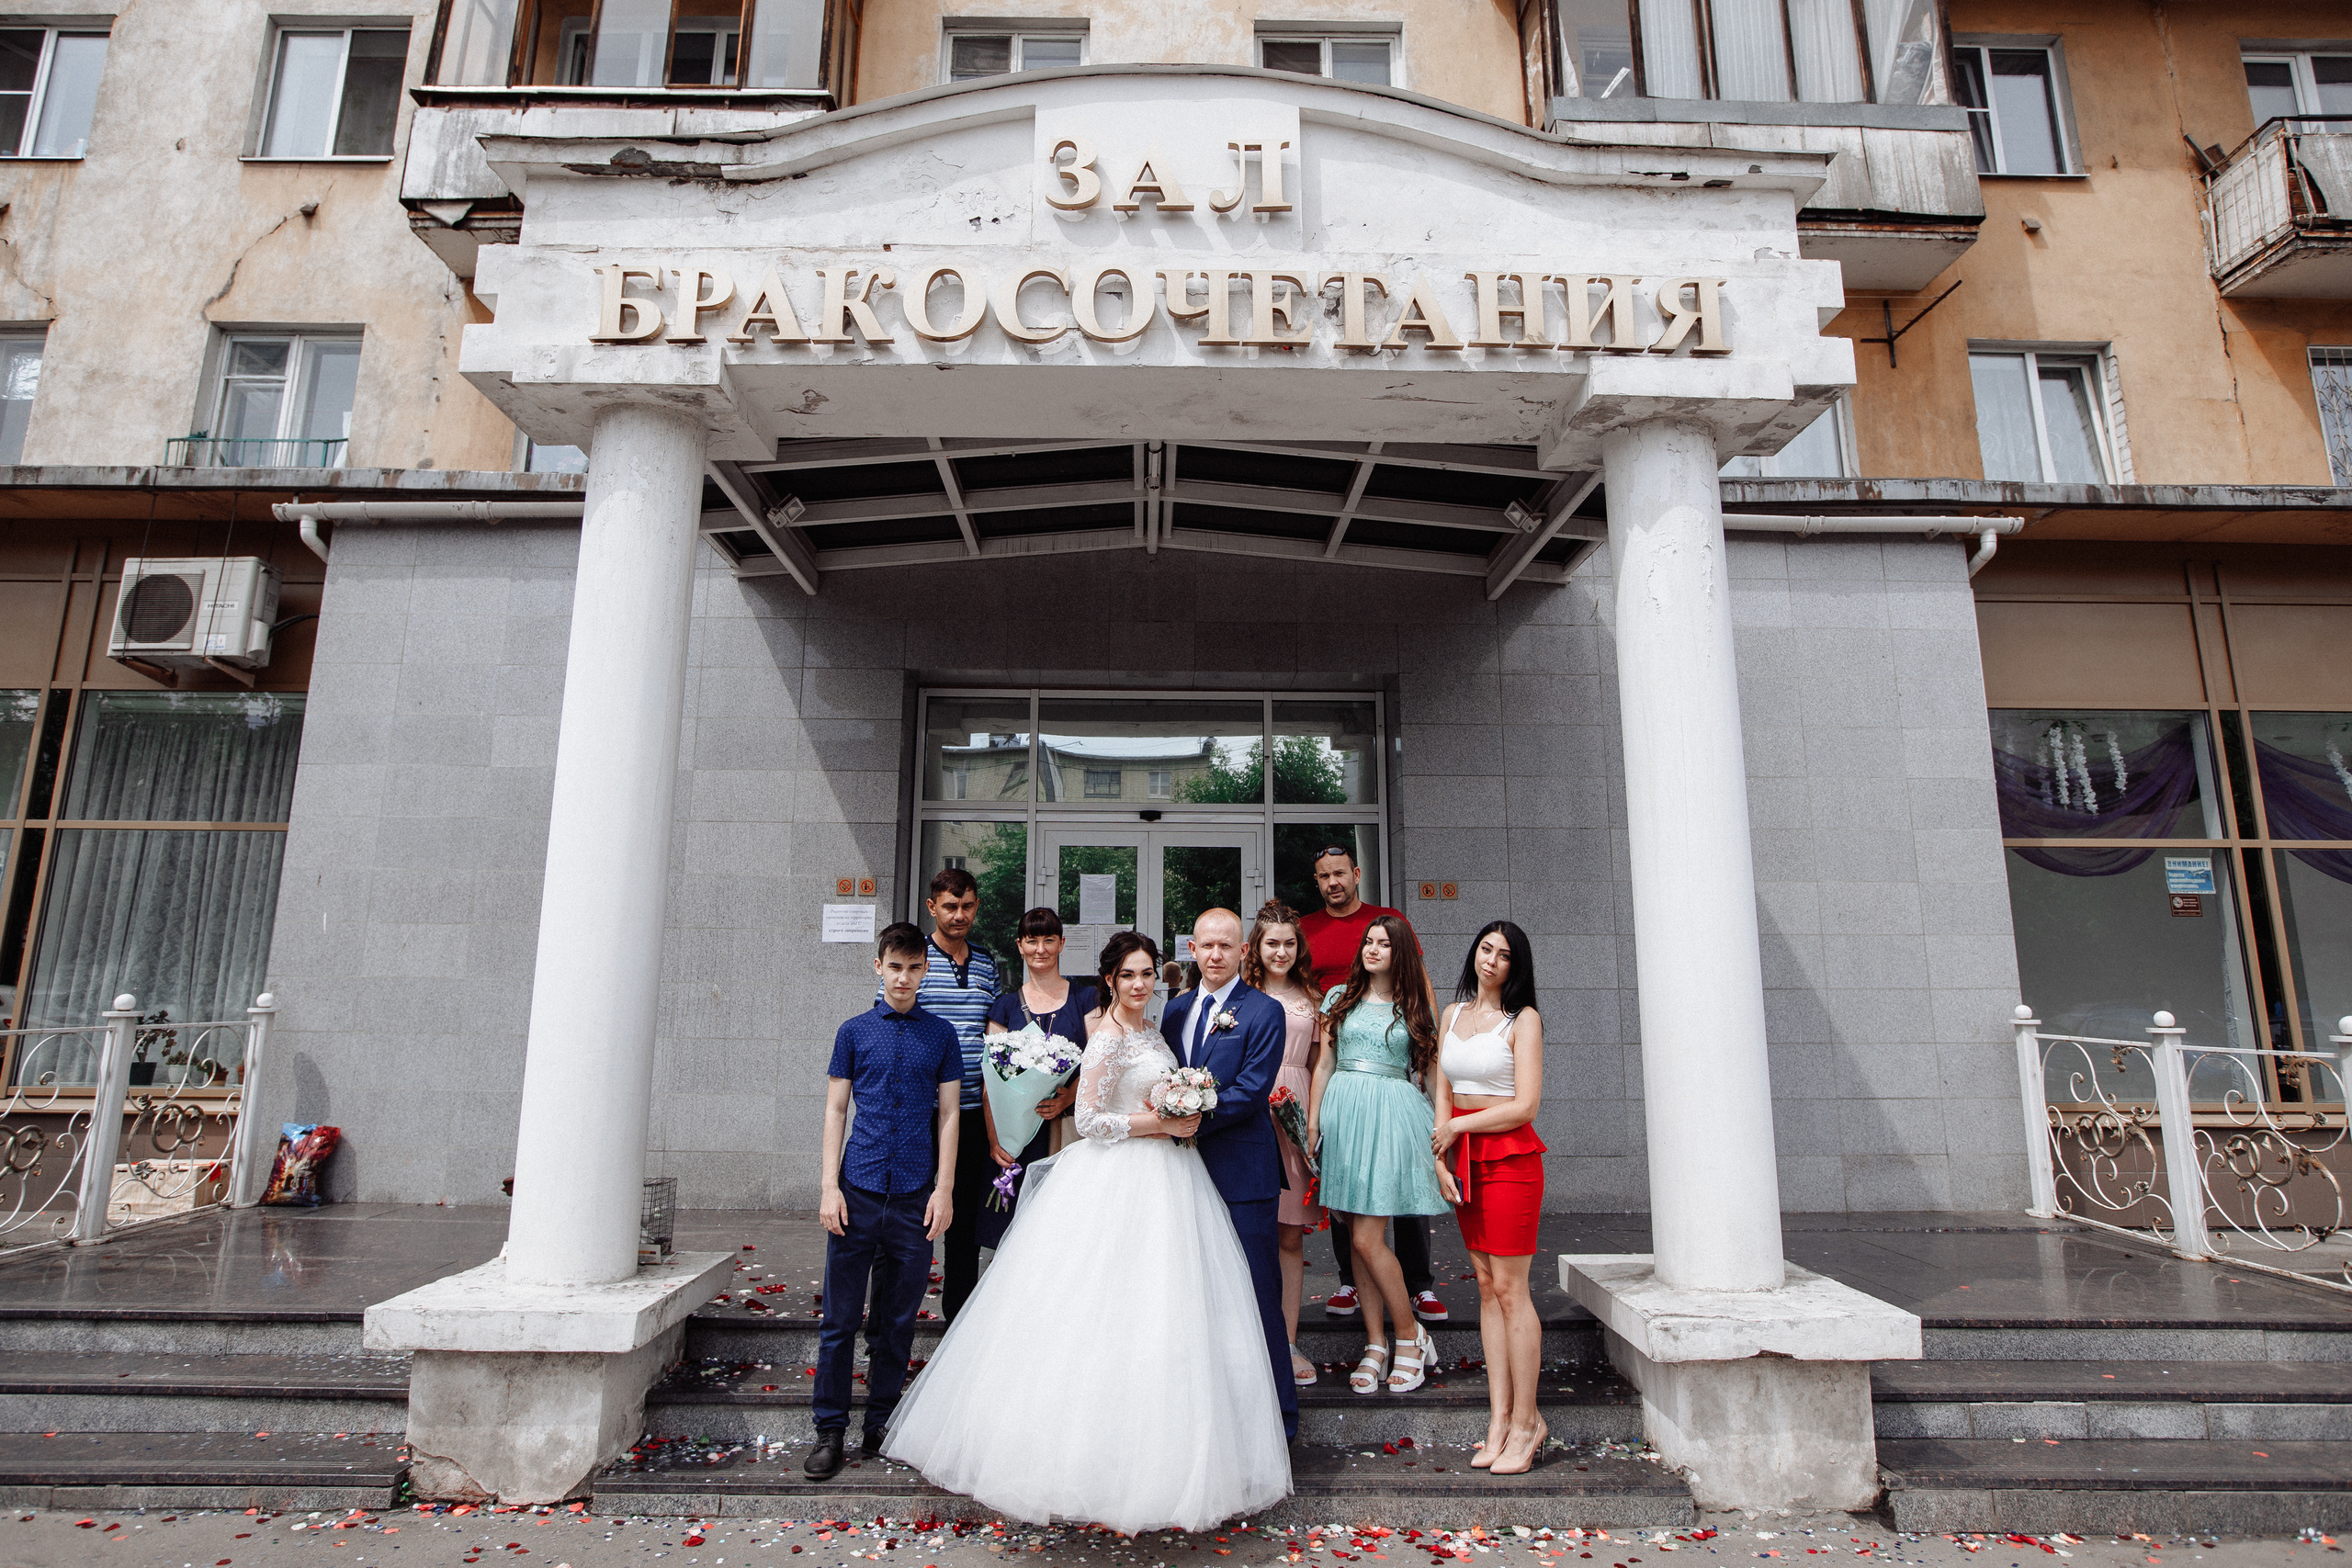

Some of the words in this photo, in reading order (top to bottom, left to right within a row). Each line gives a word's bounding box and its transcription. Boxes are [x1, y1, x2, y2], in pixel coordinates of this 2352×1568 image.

[1046, 135, 1293, 213] ЗАЛ
[588, 265, 1734, 355] БРАКОСОЧЕТАНИЯ
[2167, 860, 2209, 868] ВНИМАНИЕ!
